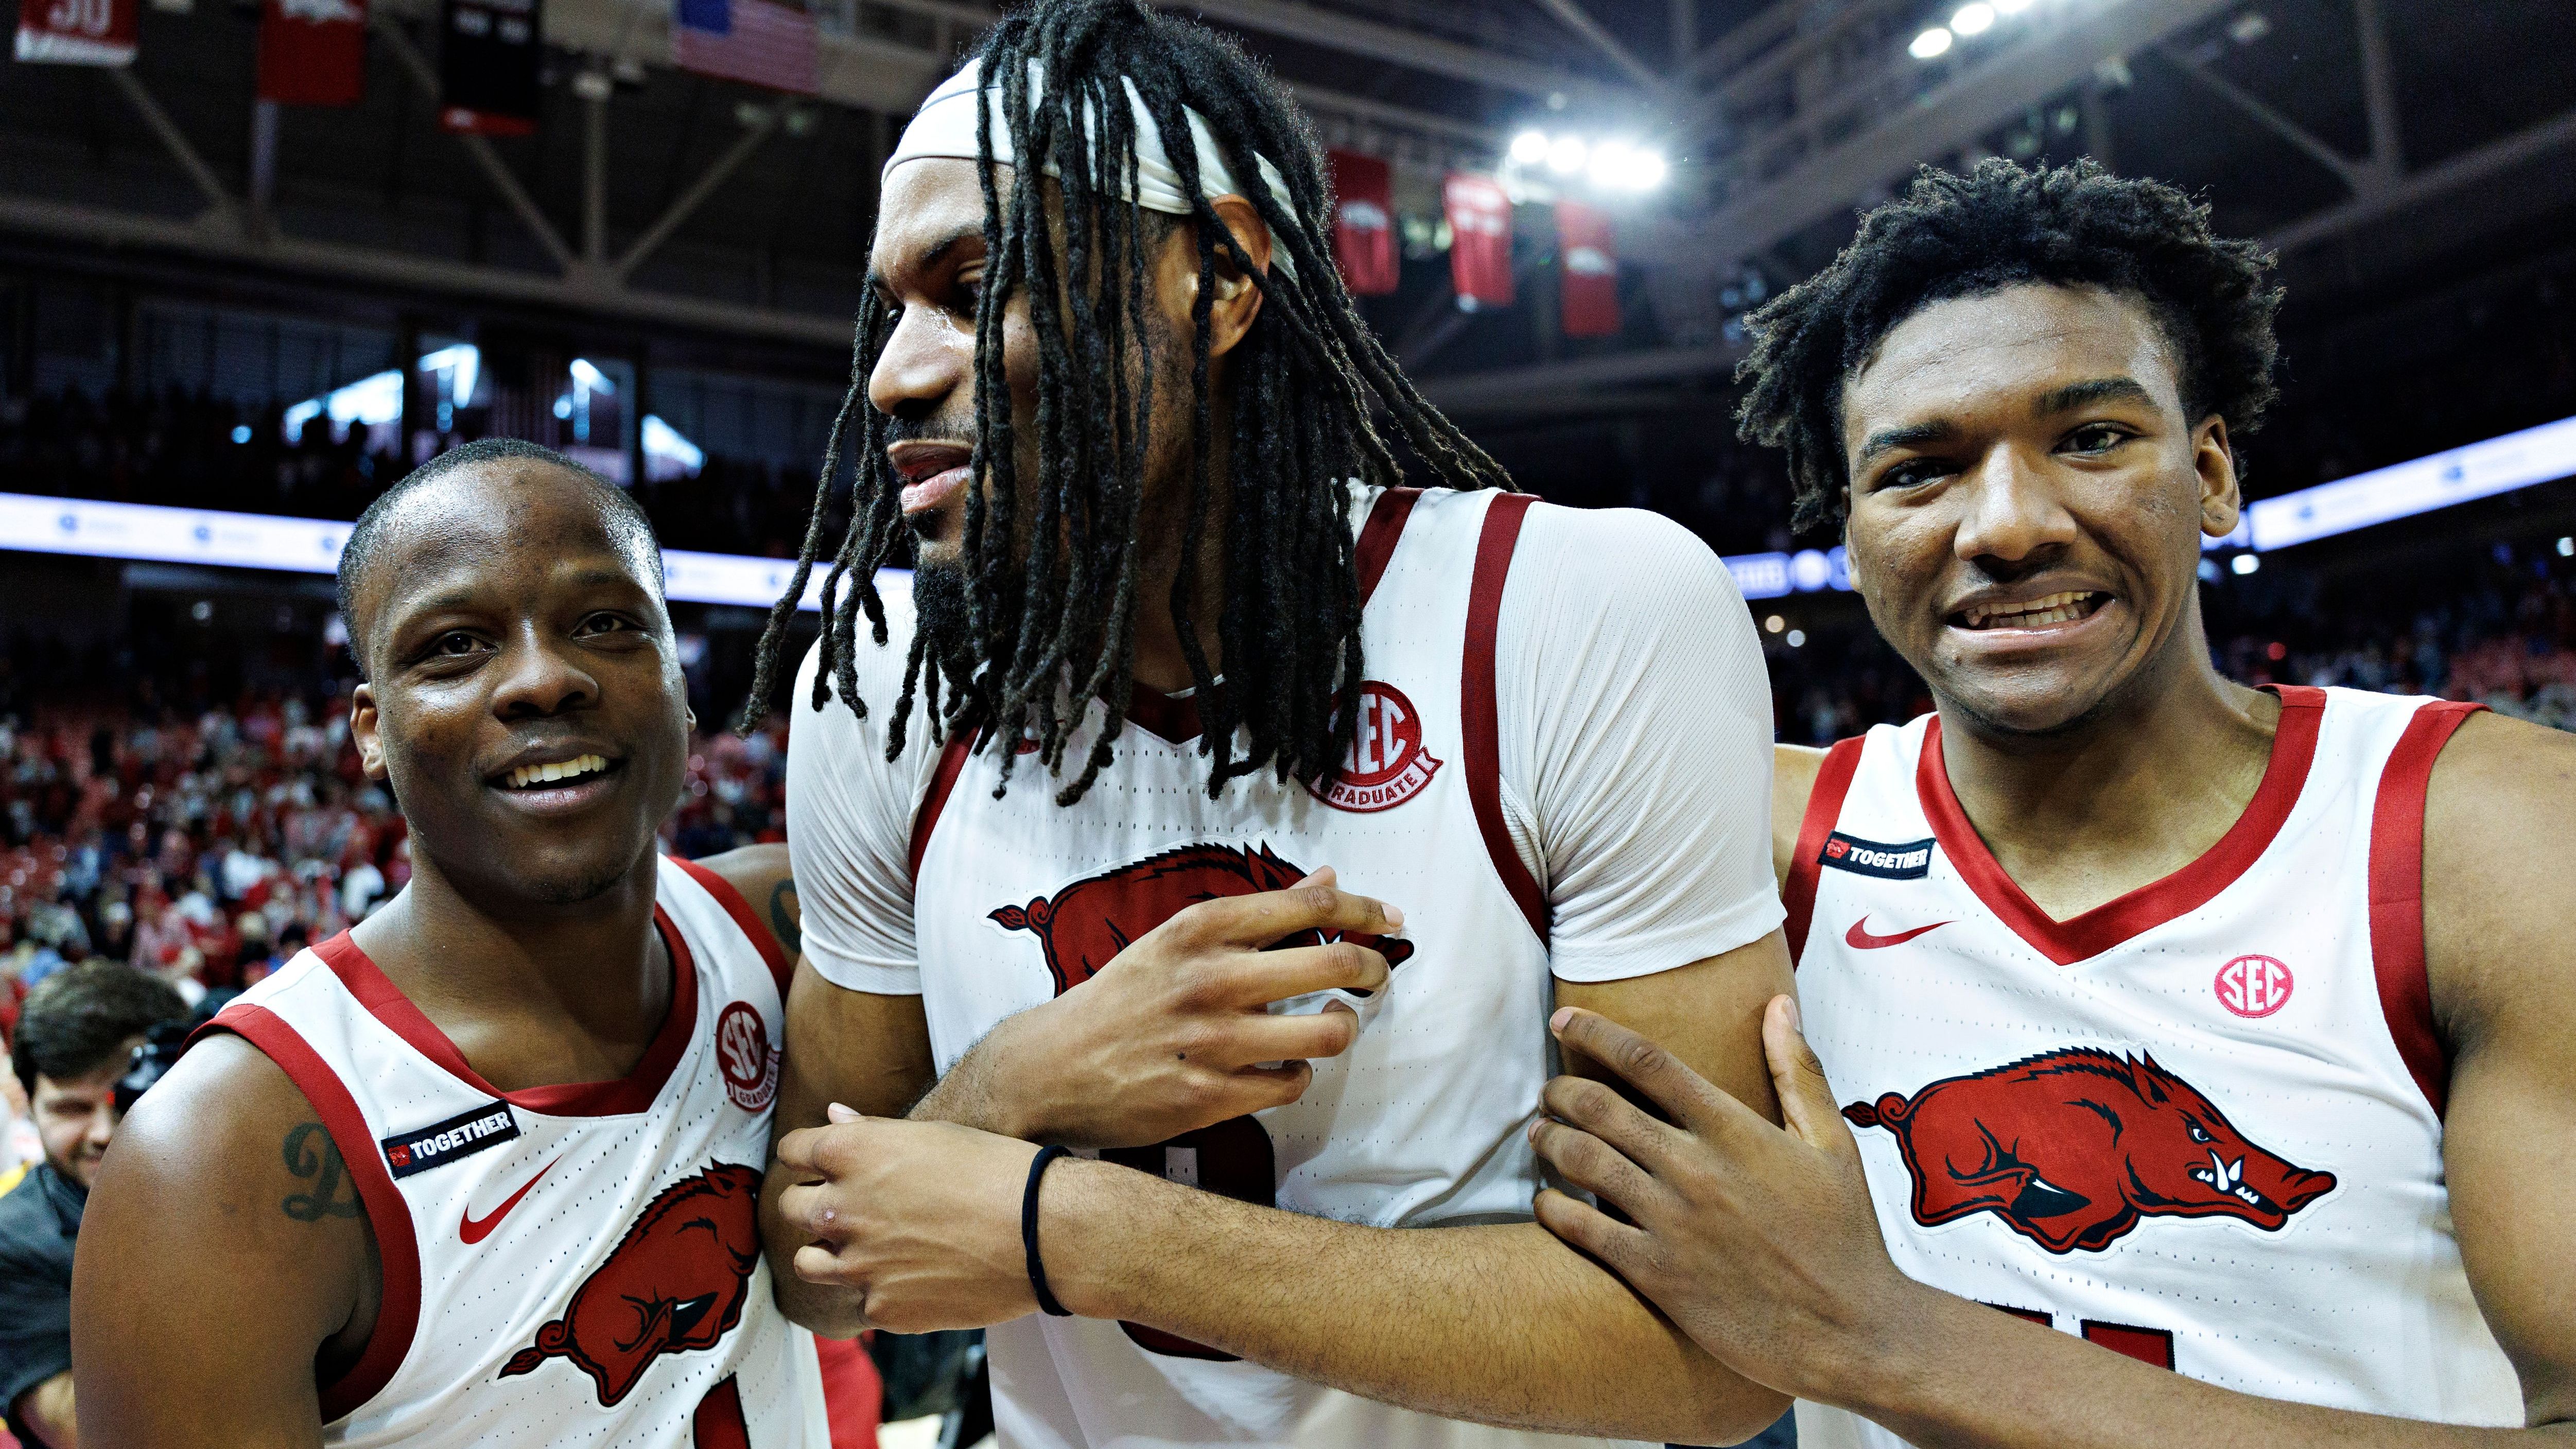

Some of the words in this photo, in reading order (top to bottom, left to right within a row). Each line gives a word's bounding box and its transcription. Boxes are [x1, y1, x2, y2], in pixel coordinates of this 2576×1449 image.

[1325, 773, 1418, 805] RADUATE
[1849, 846, 1928, 869] TOGETHER
[2222, 959, 2286, 1011] SEC
[722, 1010, 762, 1081] SEC
[409, 1111, 512, 1160] TOGETHER
